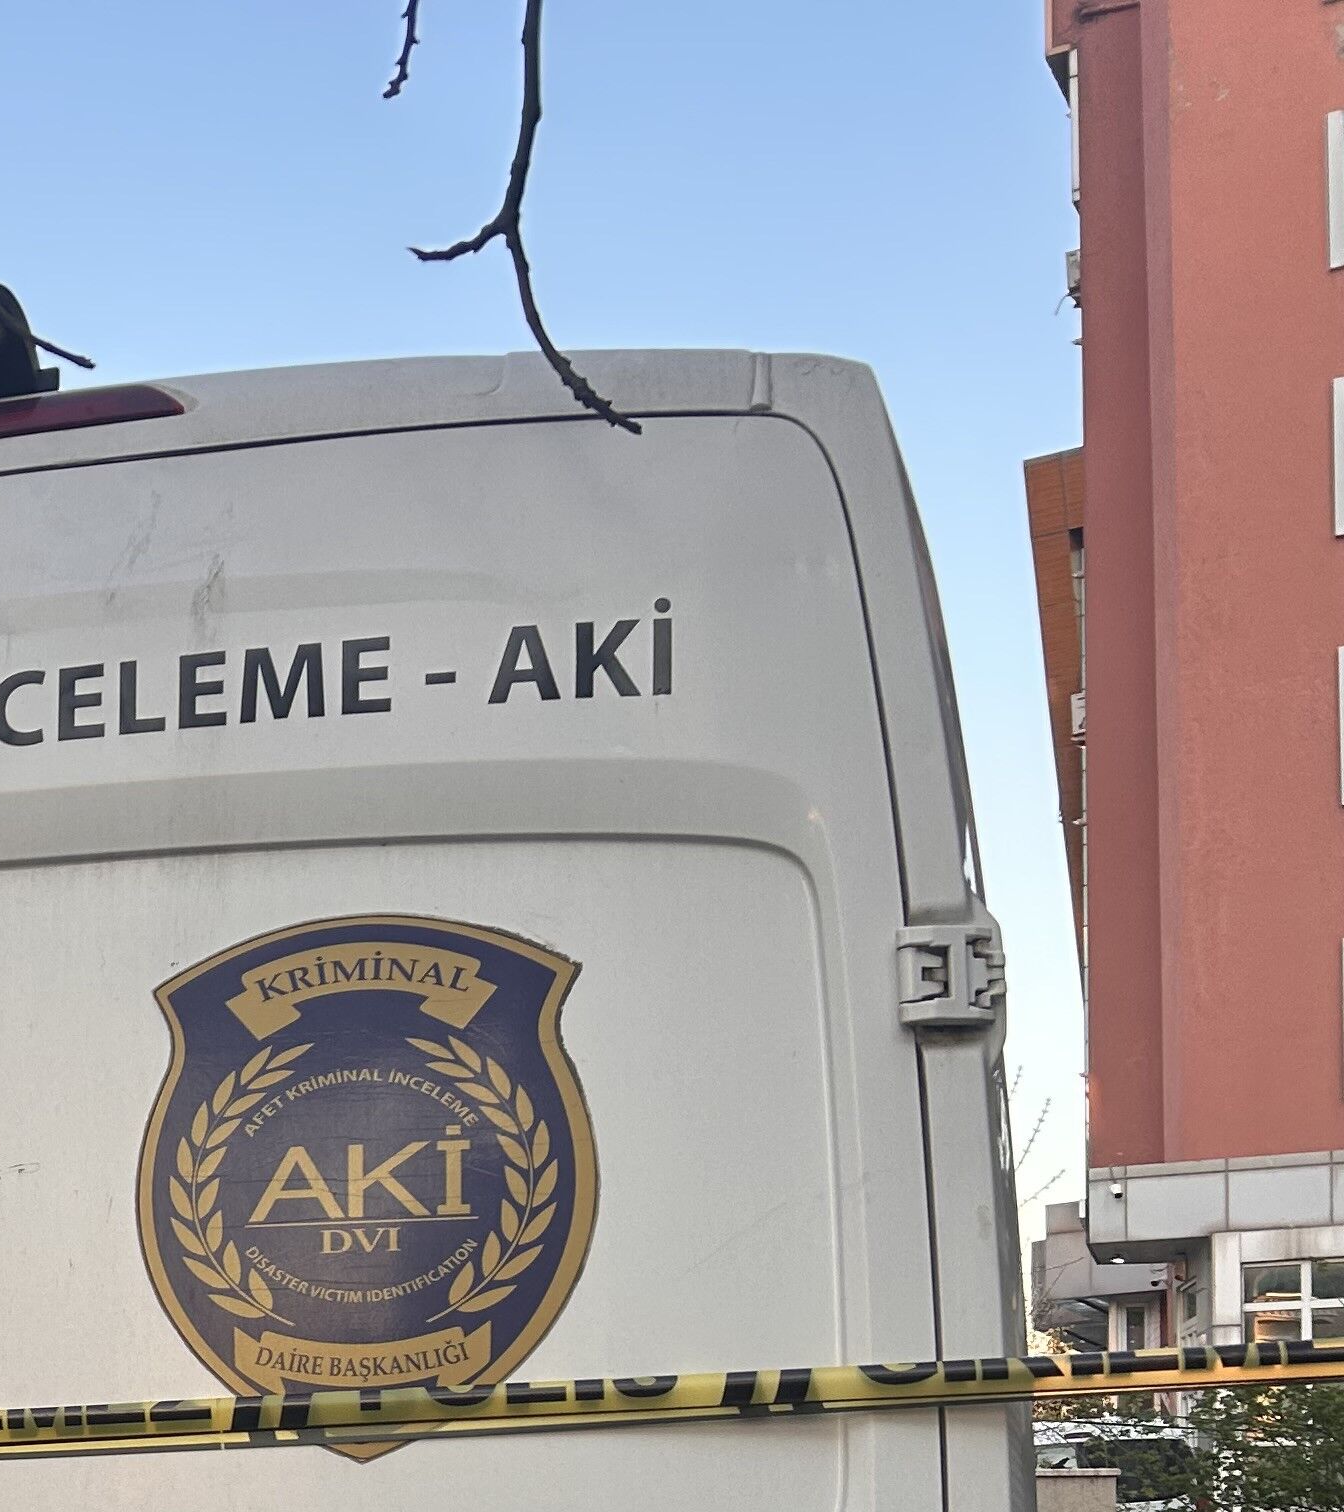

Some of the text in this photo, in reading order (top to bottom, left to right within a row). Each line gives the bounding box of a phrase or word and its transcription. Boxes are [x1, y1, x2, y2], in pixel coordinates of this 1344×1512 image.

[489, 596, 676, 704] AKİ
[255, 950, 469, 1002] KRİMİNAL
[241, 1067, 479, 1137] AFET KRİMİNAL İNCELEME
[247, 1124, 473, 1223] AKİ
[245, 1238, 478, 1304] DISASTER VICTIM IDENTIFICATION
[320, 1227, 402, 1255] DVI
[255, 1339, 470, 1383] DAİRE BAŞKANLIĞI
